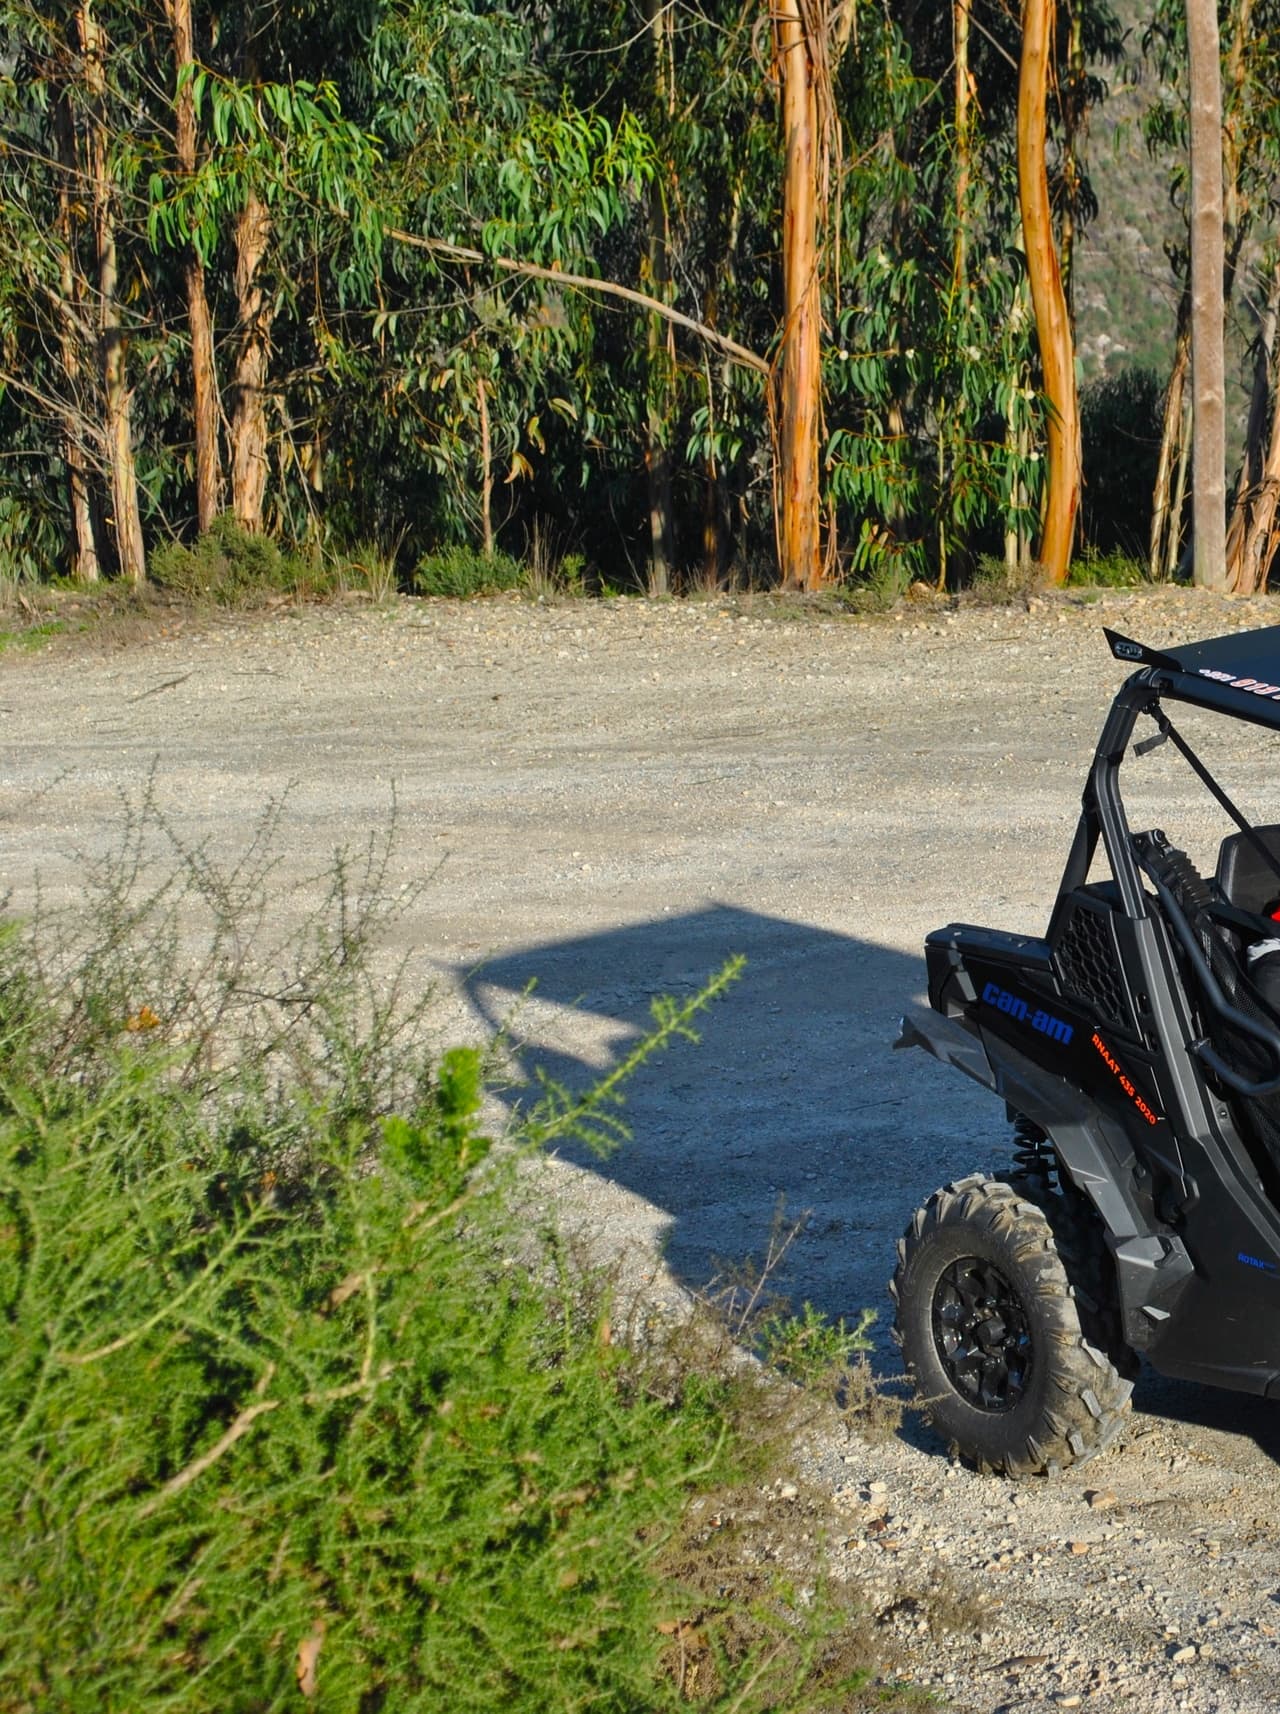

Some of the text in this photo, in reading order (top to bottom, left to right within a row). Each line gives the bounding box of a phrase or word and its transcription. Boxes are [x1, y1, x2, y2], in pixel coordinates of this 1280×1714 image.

[982, 981, 1074, 1045] can-am
[1091, 1033, 1157, 1125] RNAAT 435 2020
